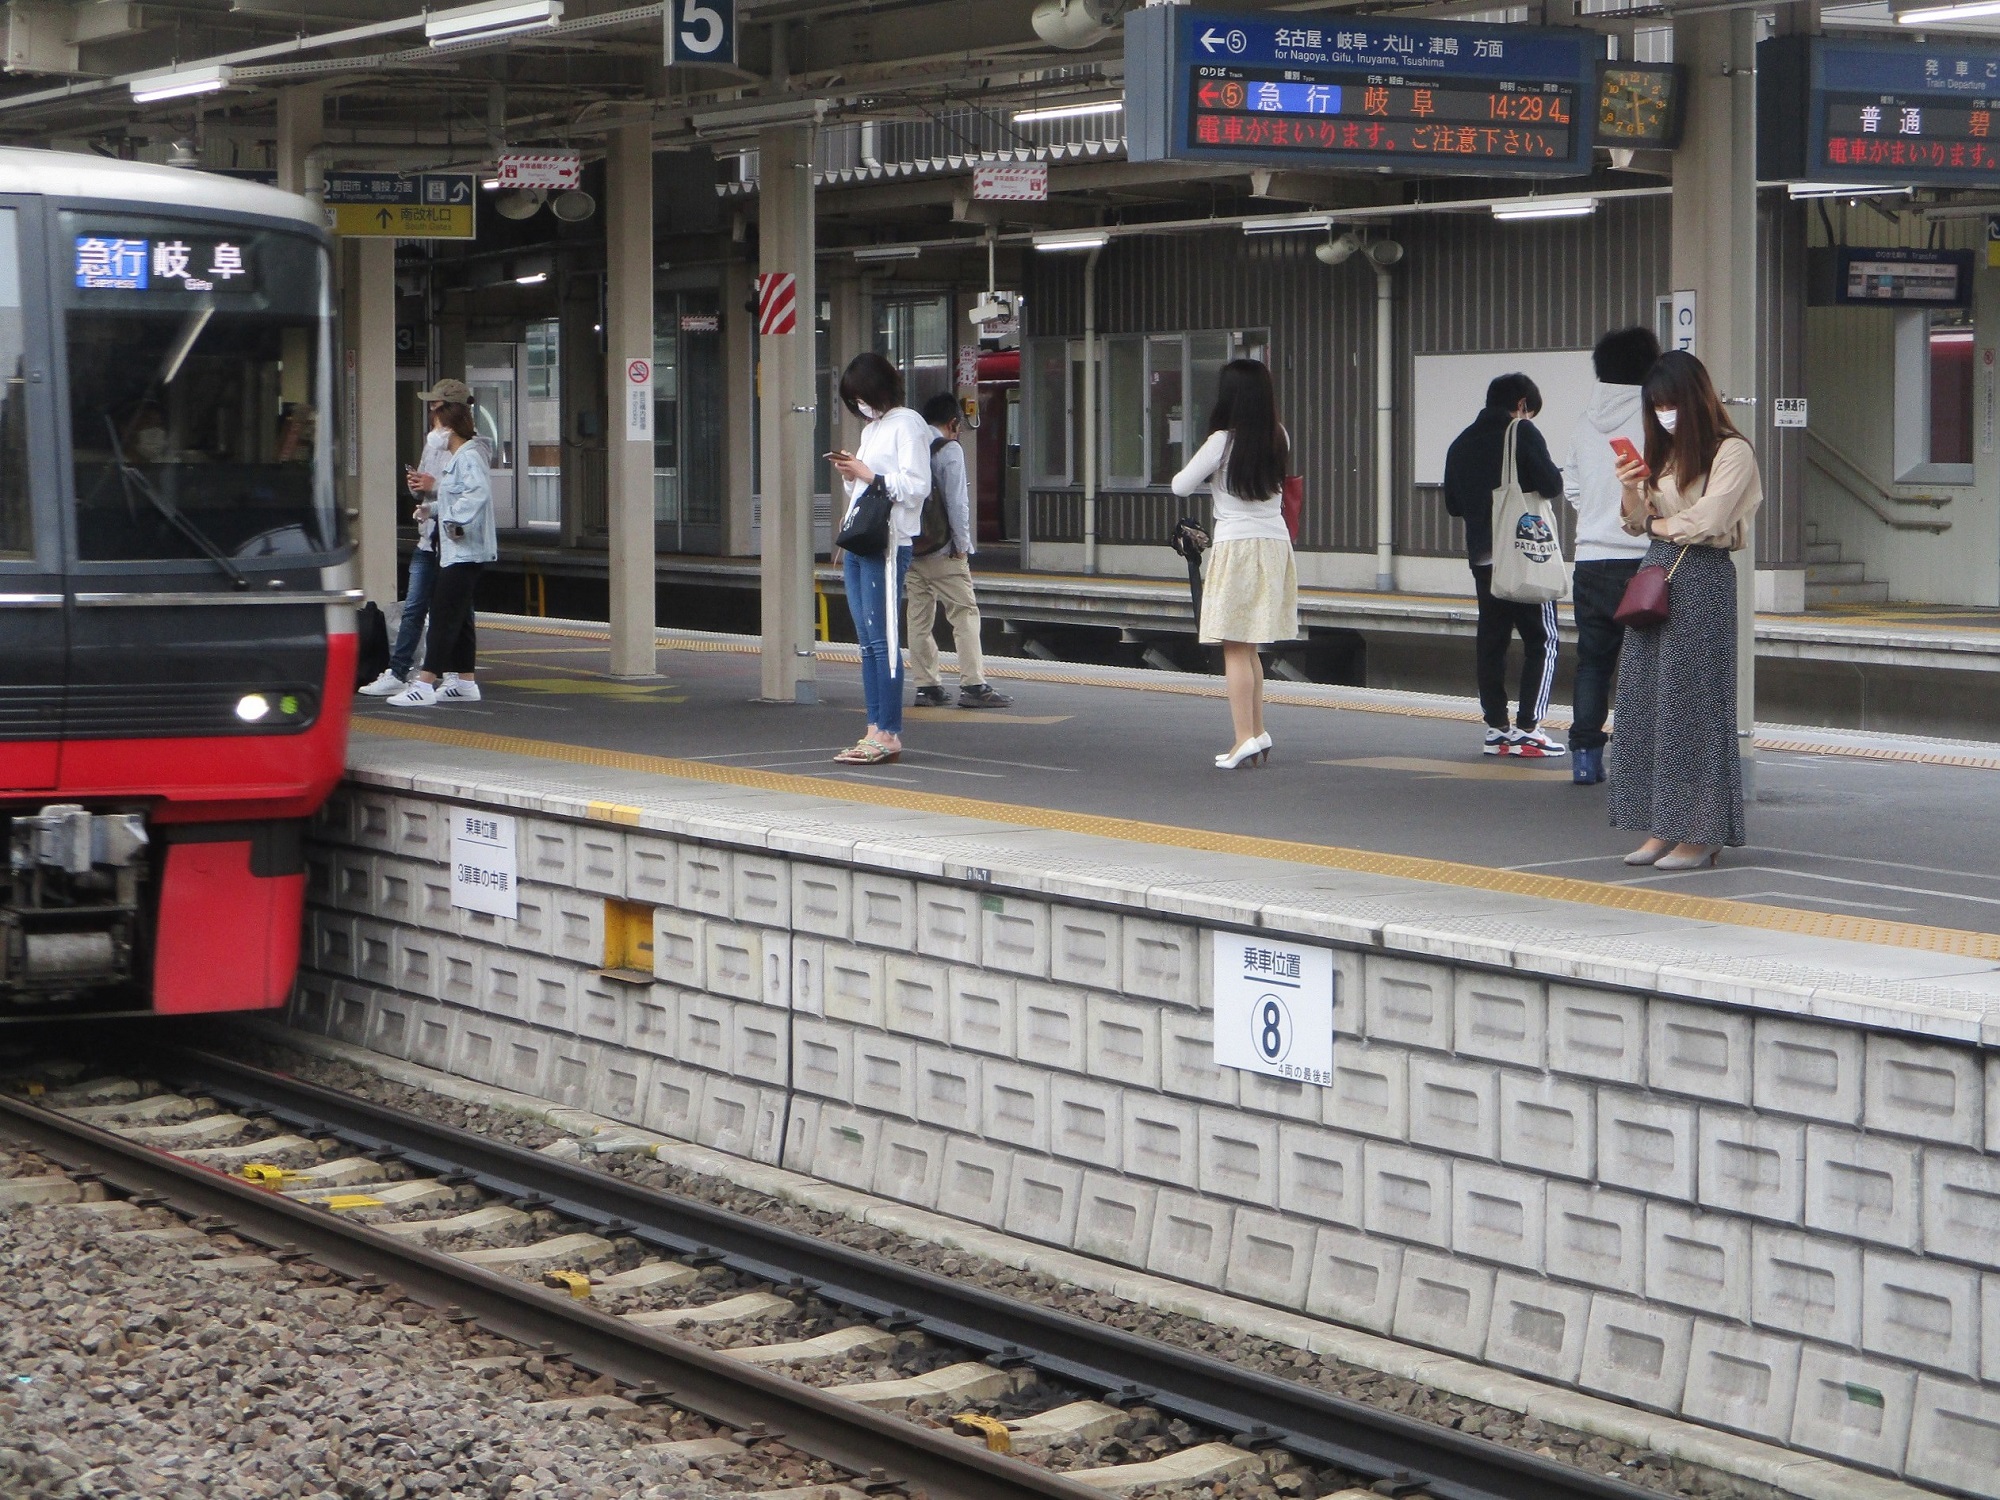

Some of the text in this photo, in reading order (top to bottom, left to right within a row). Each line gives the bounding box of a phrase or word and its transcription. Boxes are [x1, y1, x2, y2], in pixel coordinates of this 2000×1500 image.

[681, 0, 724, 53] 5
[1275, 28, 1503, 58] 名古屋・岐阜・犬山・津島 方面
[1200, 67, 1226, 77] のりば
[1275, 50, 1445, 68] for Nagoya, Gifu, Inuyama, Tsushima
[1257, 82, 1331, 113] 急行
[1926, 78, 1987, 90] Train Departure
[1364, 87, 1435, 118] 岐阜
[1489, 95, 1543, 121] 14:29
[1860, 106, 1921, 135] 普通
[1968, 110, 1990, 137] 碧
[1828, 137, 1995, 169] 電車がまいります。
[76, 238, 146, 276] 急行
[153, 241, 246, 280] 岐阜
[466, 818, 498, 840] 乗車位置
[458, 863, 508, 892] 3扉車の中扉
[1244, 947, 1300, 978] 乗車位置
[1262, 1001, 1281, 1058] 8
[1278, 1064, 1331, 1084] 4両の最後部
